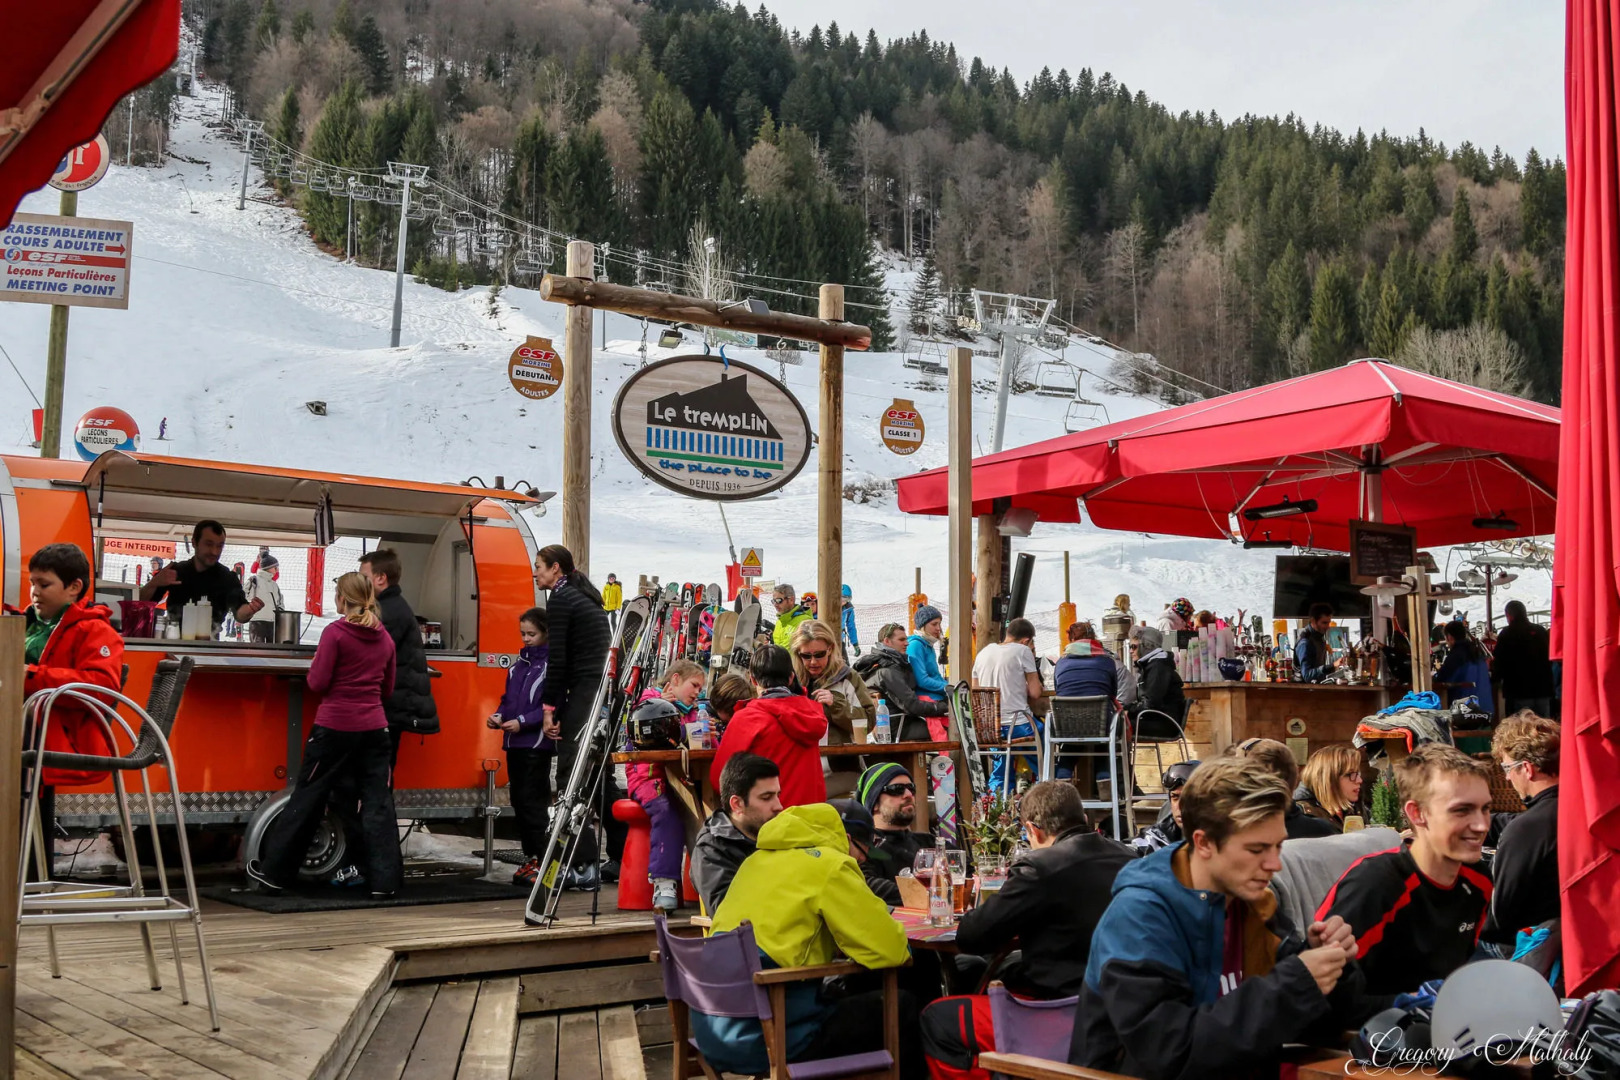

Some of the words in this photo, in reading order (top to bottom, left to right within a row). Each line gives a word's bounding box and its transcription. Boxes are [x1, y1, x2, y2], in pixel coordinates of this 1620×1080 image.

[6, 223, 123, 241] RASSEMBLEMENT
[3, 235, 49, 248] COURS
[53, 240, 104, 252] ADULTE
[7, 265, 43, 278] Leçons
[47, 268, 116, 282] Particulières
[7, 279, 68, 293] MEETING
[73, 284, 115, 296] POINT
[522, 359, 551, 368] MORZINE
[654, 401, 677, 422] Le
[85, 418, 115, 426] ESF
[888, 429, 911, 438] CLASSE
[734, 467, 750, 477] to
[753, 469, 773, 479] be
[689, 479, 720, 491] DEPUIS
[723, 481, 741, 491] 1936
[104, 540, 122, 549] UGE
[125, 542, 172, 553] INTERDITE
